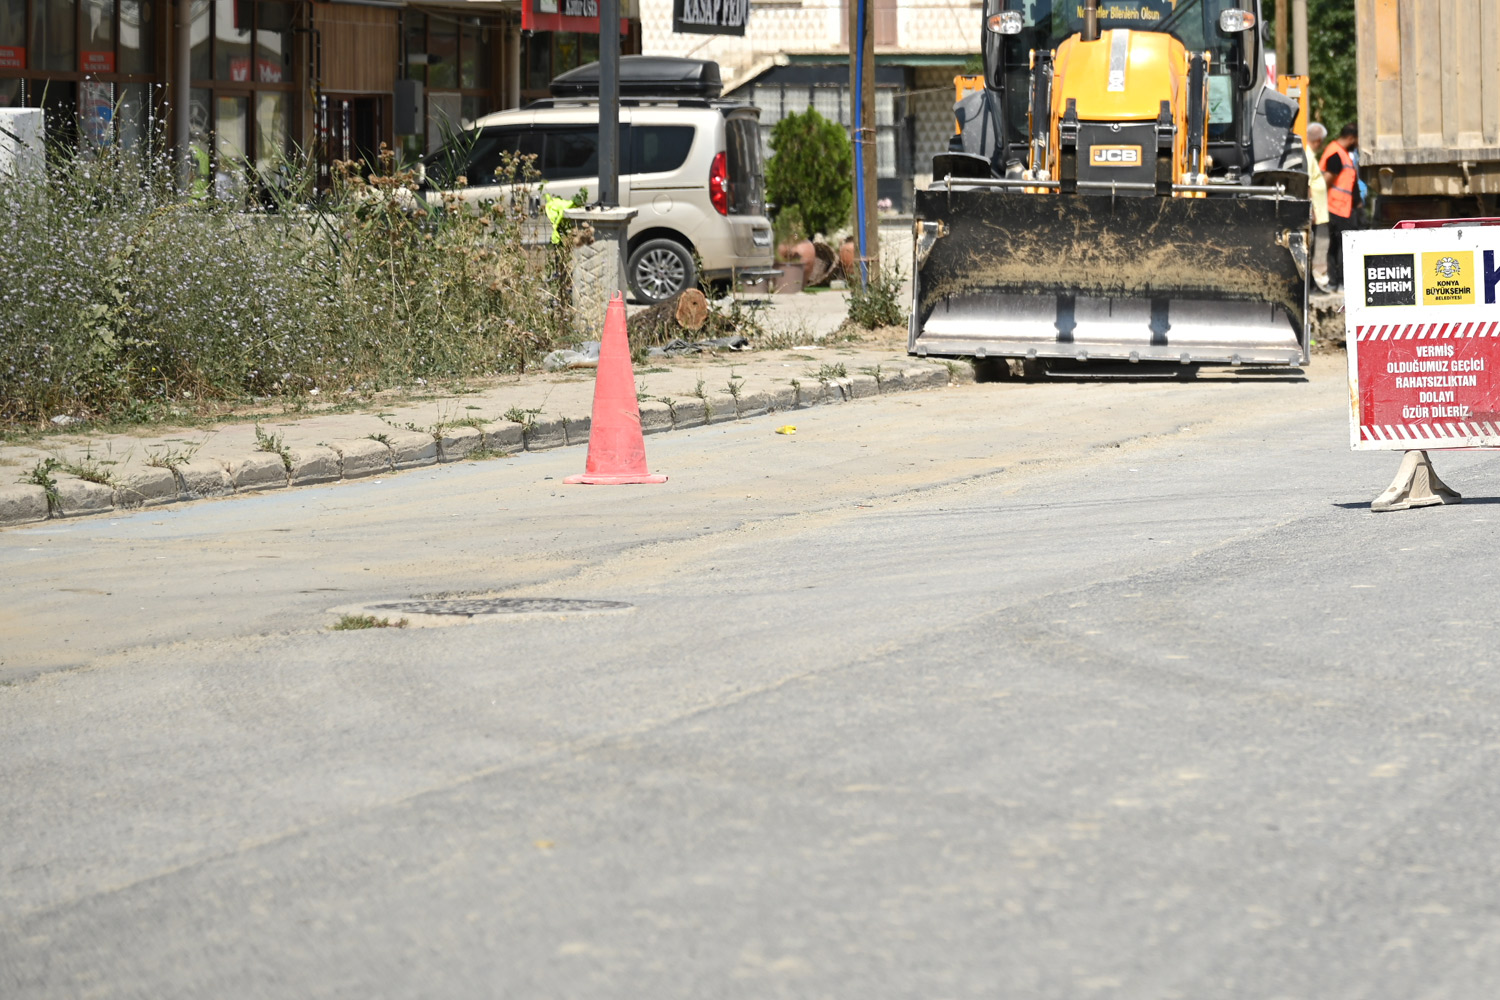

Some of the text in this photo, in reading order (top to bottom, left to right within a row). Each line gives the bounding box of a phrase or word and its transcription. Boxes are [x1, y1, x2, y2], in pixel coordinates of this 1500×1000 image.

[1140, 6, 1160, 21] Olsun
[1094, 149, 1137, 162] JCB
[1425, 287, 1471, 296] BÜYÜKŞEHİR
[1416, 343, 1455, 358] VERMİŞ
[1387, 357, 1485, 373] OLDUĞUMUZ GEÇİCİ
[1395, 375, 1477, 388] RAHATSIZLIKTAN
[1419, 391, 1454, 403] DOLAYI
[1402, 404, 1469, 418] ÖZÜR DİLERİZ
